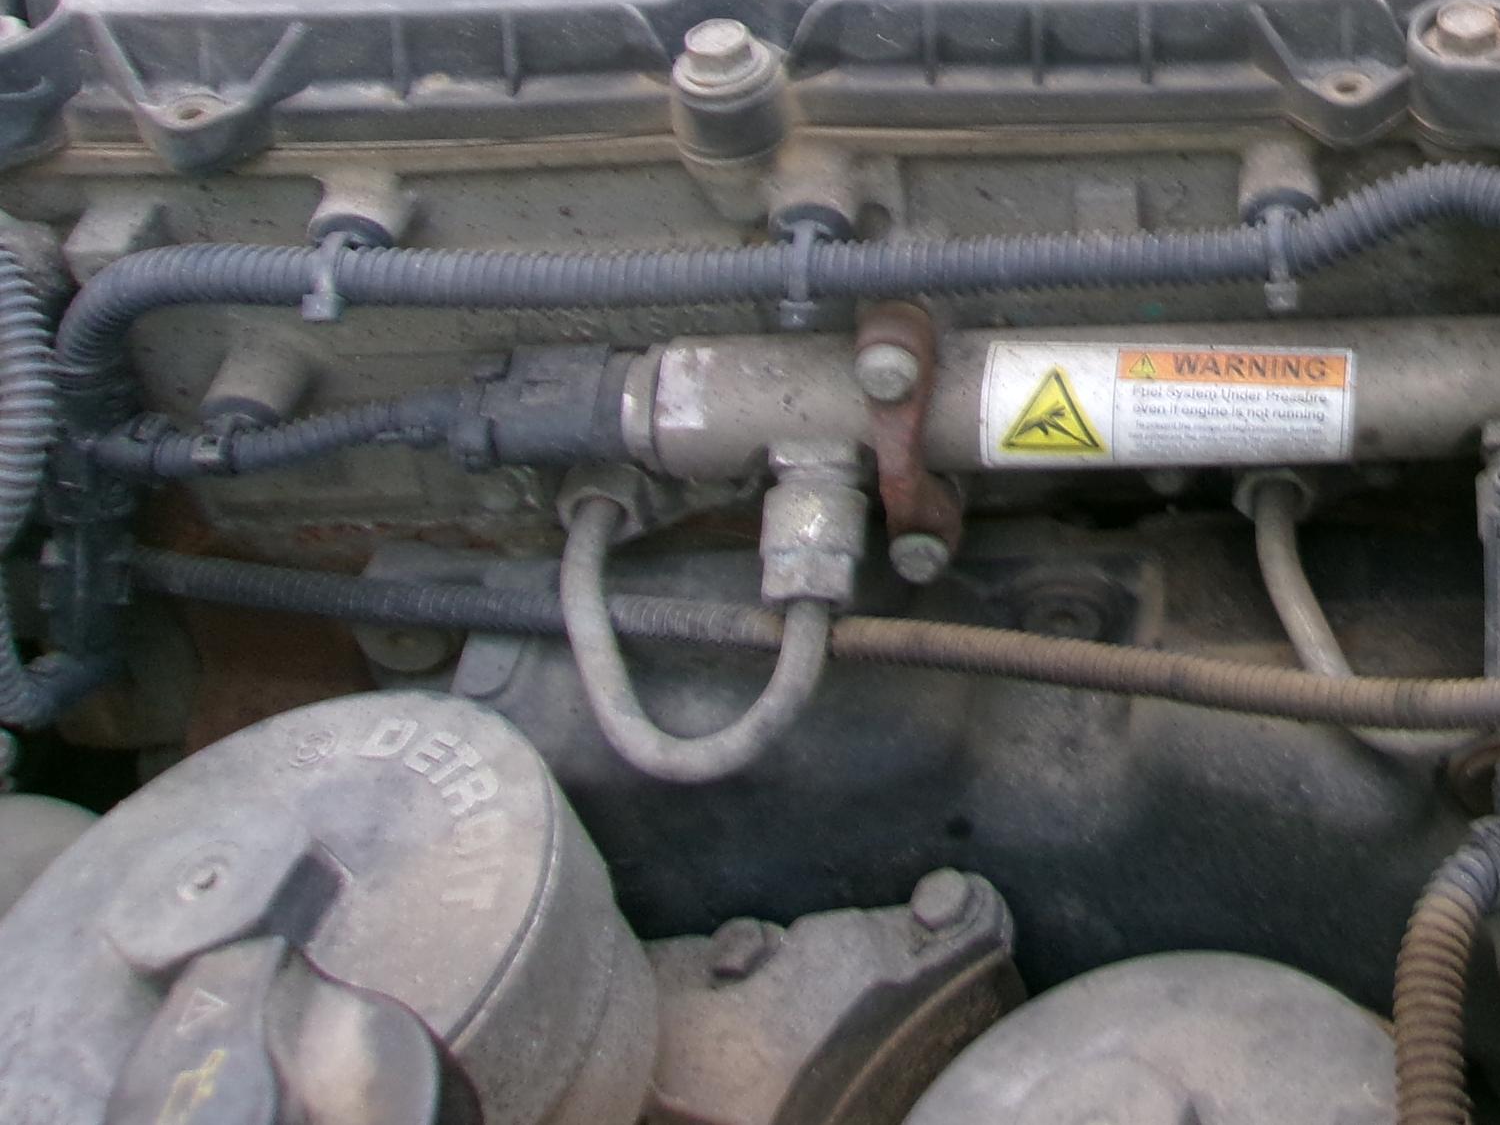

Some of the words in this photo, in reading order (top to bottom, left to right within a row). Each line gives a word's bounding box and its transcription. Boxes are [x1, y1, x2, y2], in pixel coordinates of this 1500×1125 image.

[1173, 353, 1326, 380] WARNING
[1167, 386, 1217, 402] System
[1221, 387, 1260, 402] Under
[1266, 388, 1328, 405] Pressure
[1132, 403, 1167, 415] even
[1181, 405, 1229, 419] engine
[1247, 407, 1269, 420] not
[1272, 407, 1327, 423] running
[360, 717, 504, 911] DETROIT
